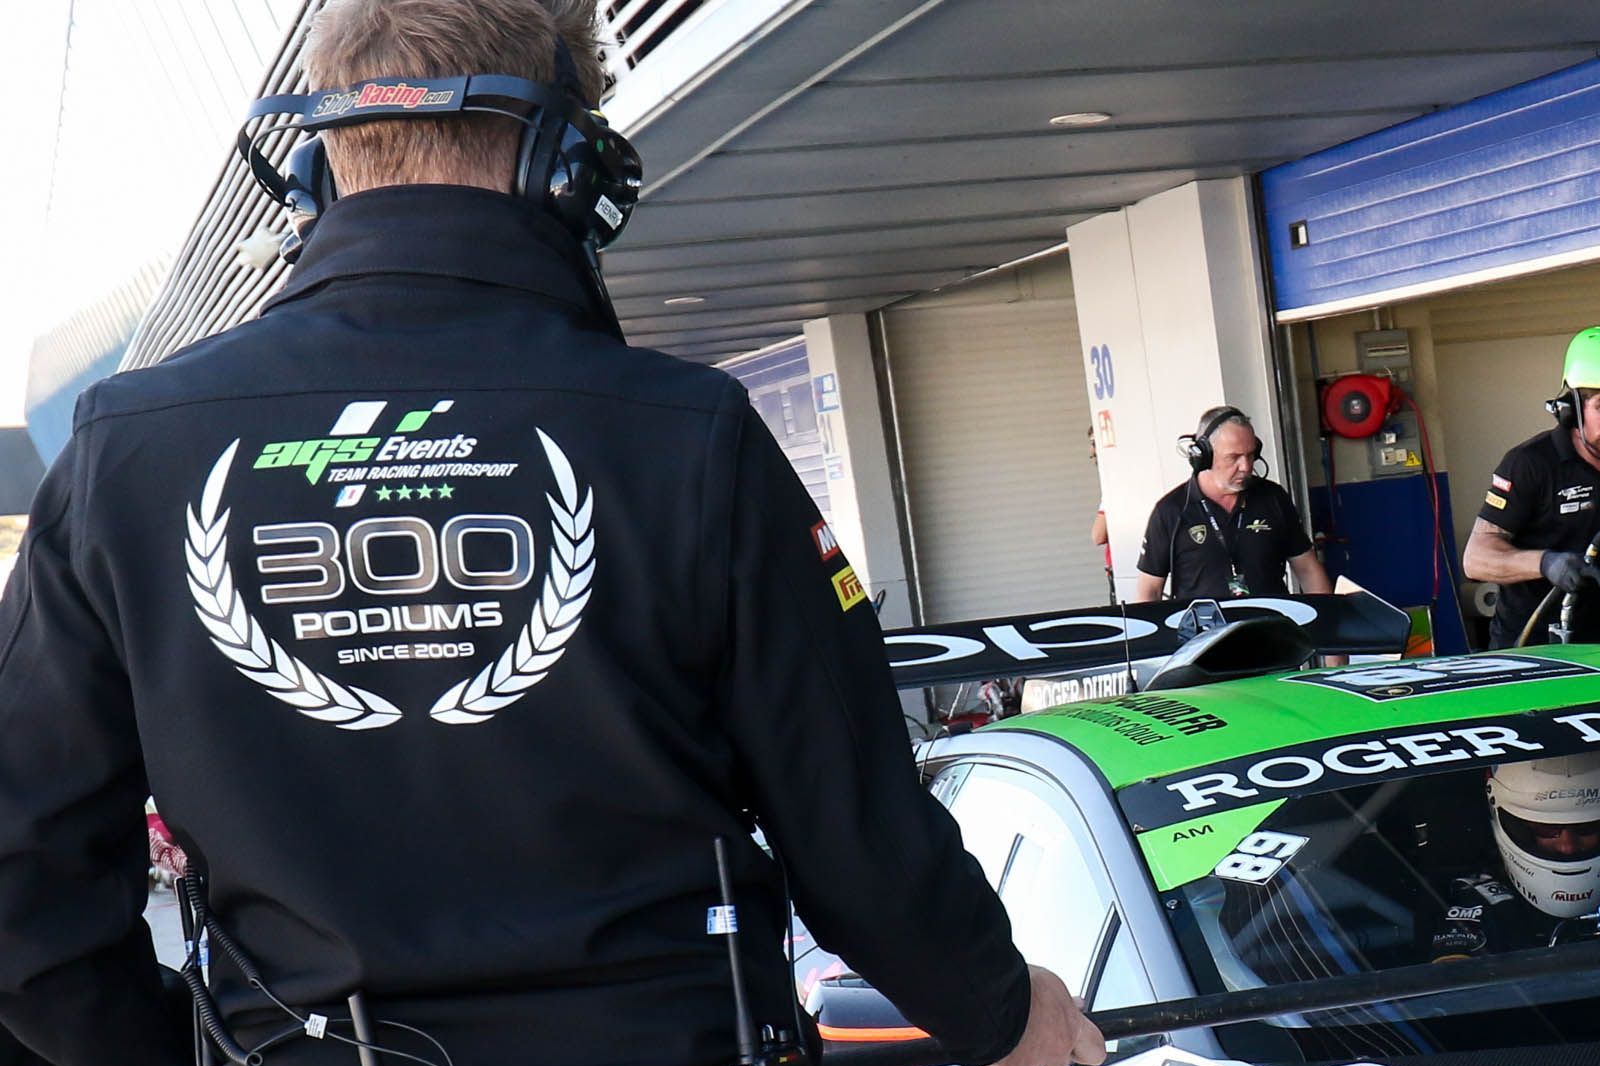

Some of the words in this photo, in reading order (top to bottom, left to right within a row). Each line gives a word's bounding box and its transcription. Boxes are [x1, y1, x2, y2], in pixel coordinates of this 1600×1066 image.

[1090, 344, 1115, 400] 30
[376, 434, 477, 462] Events
[328, 467, 367, 482] TEAM
[367, 465, 420, 481] RACING
[420, 463, 519, 479] MOTORSPORT
[253, 514, 535, 604] 300
[293, 602, 504, 640] PODIUMS
[338, 643, 409, 664] SINCE
[414, 642, 475, 658] 2009
[1166, 721, 1544, 811] ROGER
[1547, 788, 1600, 800] CESAM
[1172, 822, 1214, 843] AM
[1216, 831, 1295, 882] 89
[1447, 908, 1483, 919] OMP
